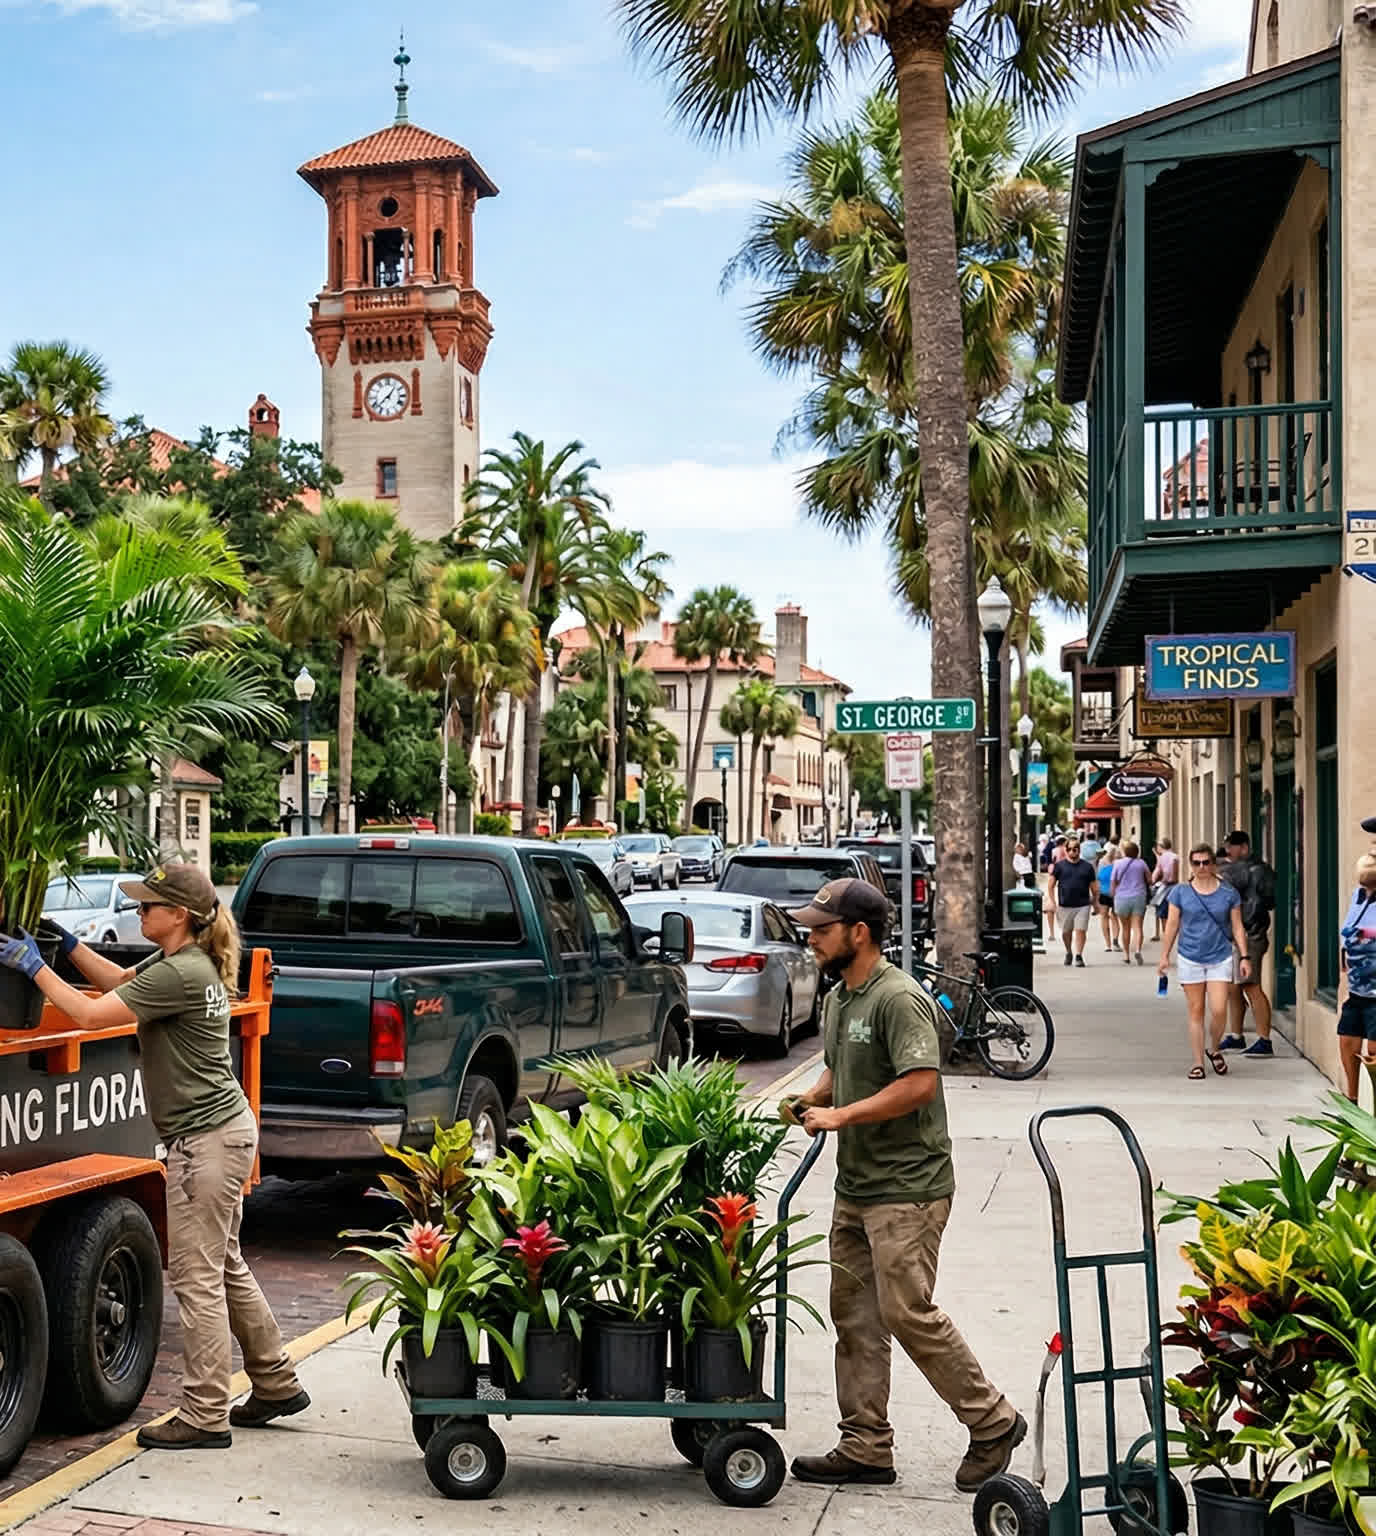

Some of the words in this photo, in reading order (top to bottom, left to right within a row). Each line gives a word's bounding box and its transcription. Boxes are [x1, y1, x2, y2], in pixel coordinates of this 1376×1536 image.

[1157, 643, 1285, 666] TROPICAL
[1184, 667, 1259, 689] FINDS
[842, 706, 867, 728] ST.
[874, 705, 945, 728] GEORGE
[55, 1068, 147, 1135] FLORA
